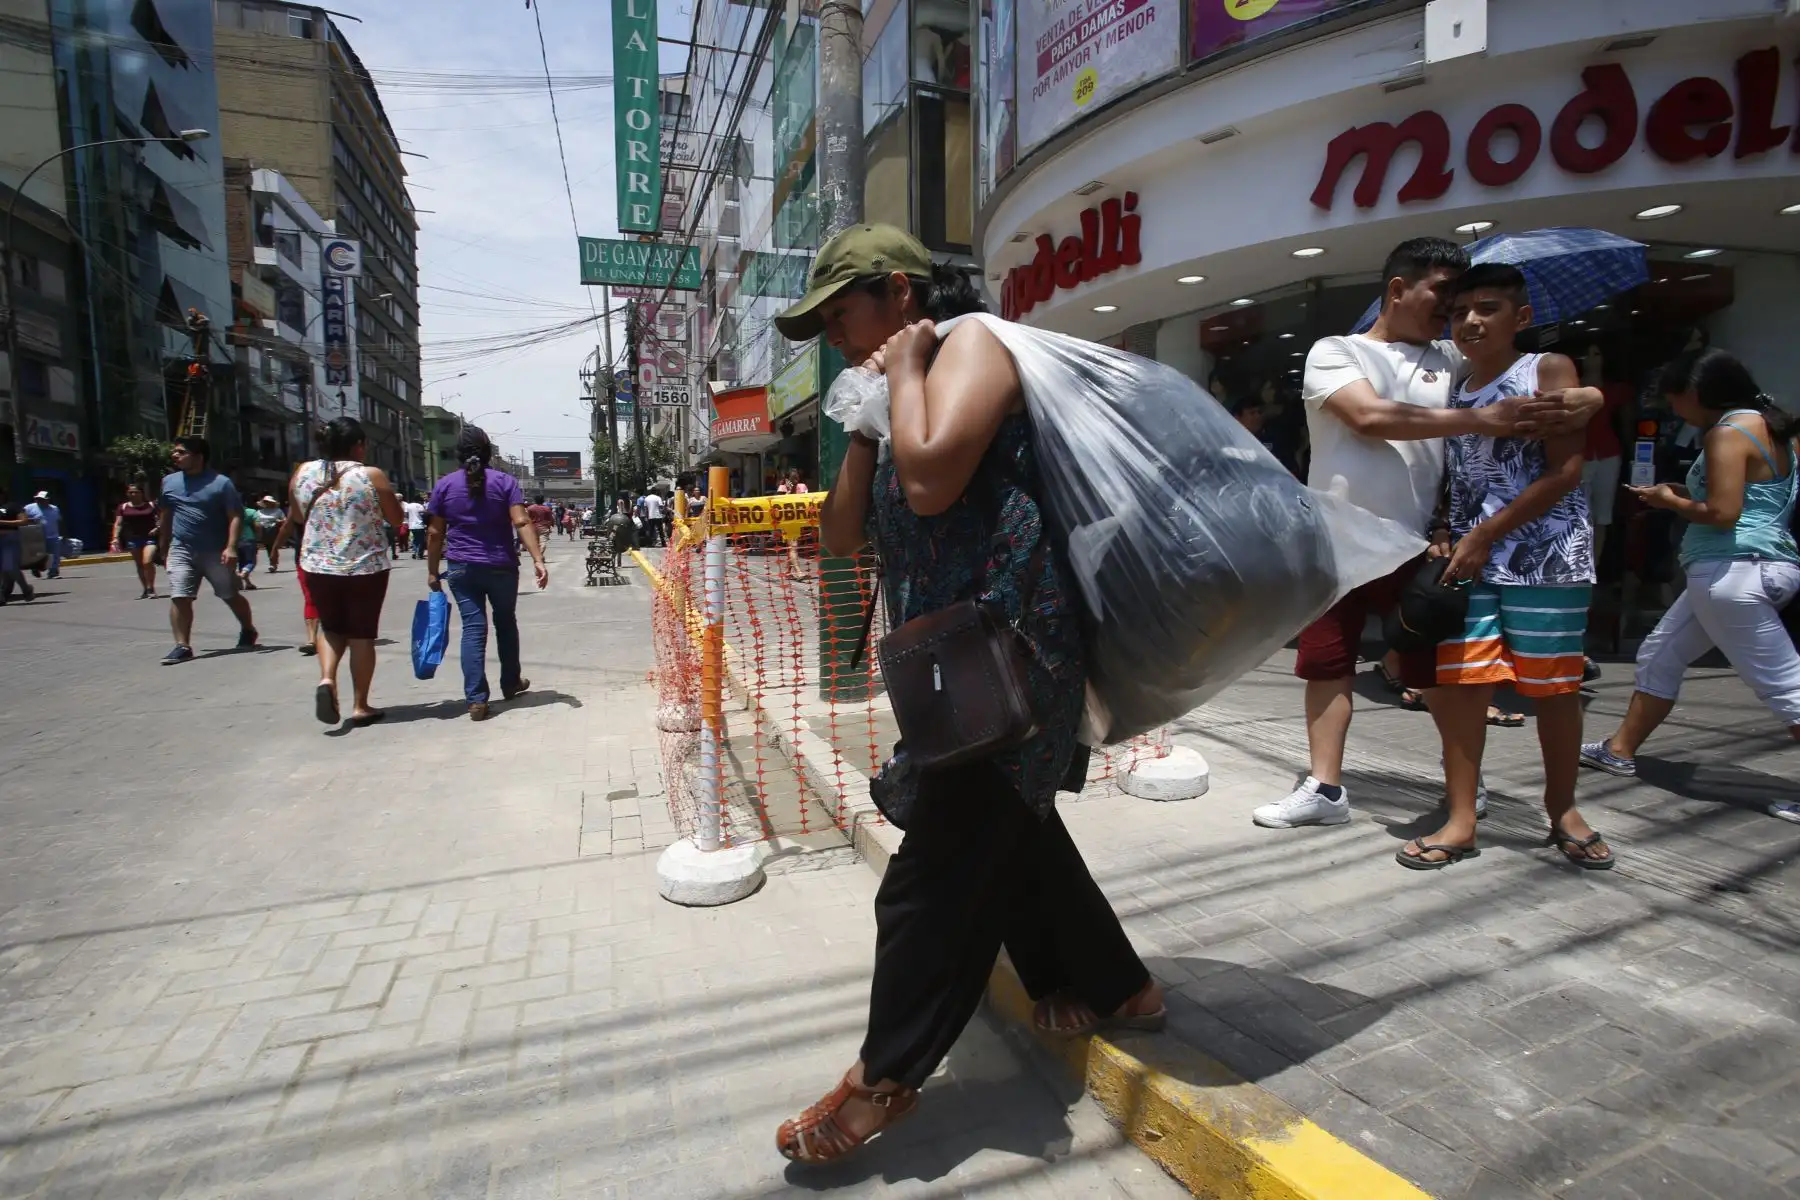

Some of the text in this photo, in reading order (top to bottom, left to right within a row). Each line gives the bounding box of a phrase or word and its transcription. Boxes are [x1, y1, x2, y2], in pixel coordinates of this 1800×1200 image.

[1032, 78, 1051, 103] POR
[1053, 49, 1090, 87] AMYOR
[1094, 37, 1102, 55] Y
[1106, 6, 1155, 49] MENOR
[1036, 18, 1065, 53] VENTA
[1068, 6, 1083, 28] DE
[1051, 2, 1125, 64] PARA DAMAS
[1076, 81, 1094, 100] 209
[626, 77, 651, 225] TORRE
[1310, 46, 1800, 212] model
[585, 242, 608, 264] DE
[1001, 191, 1142, 322] modelli
[654, 391, 689, 403] 1560
[710, 505, 764, 525] LIGRO
